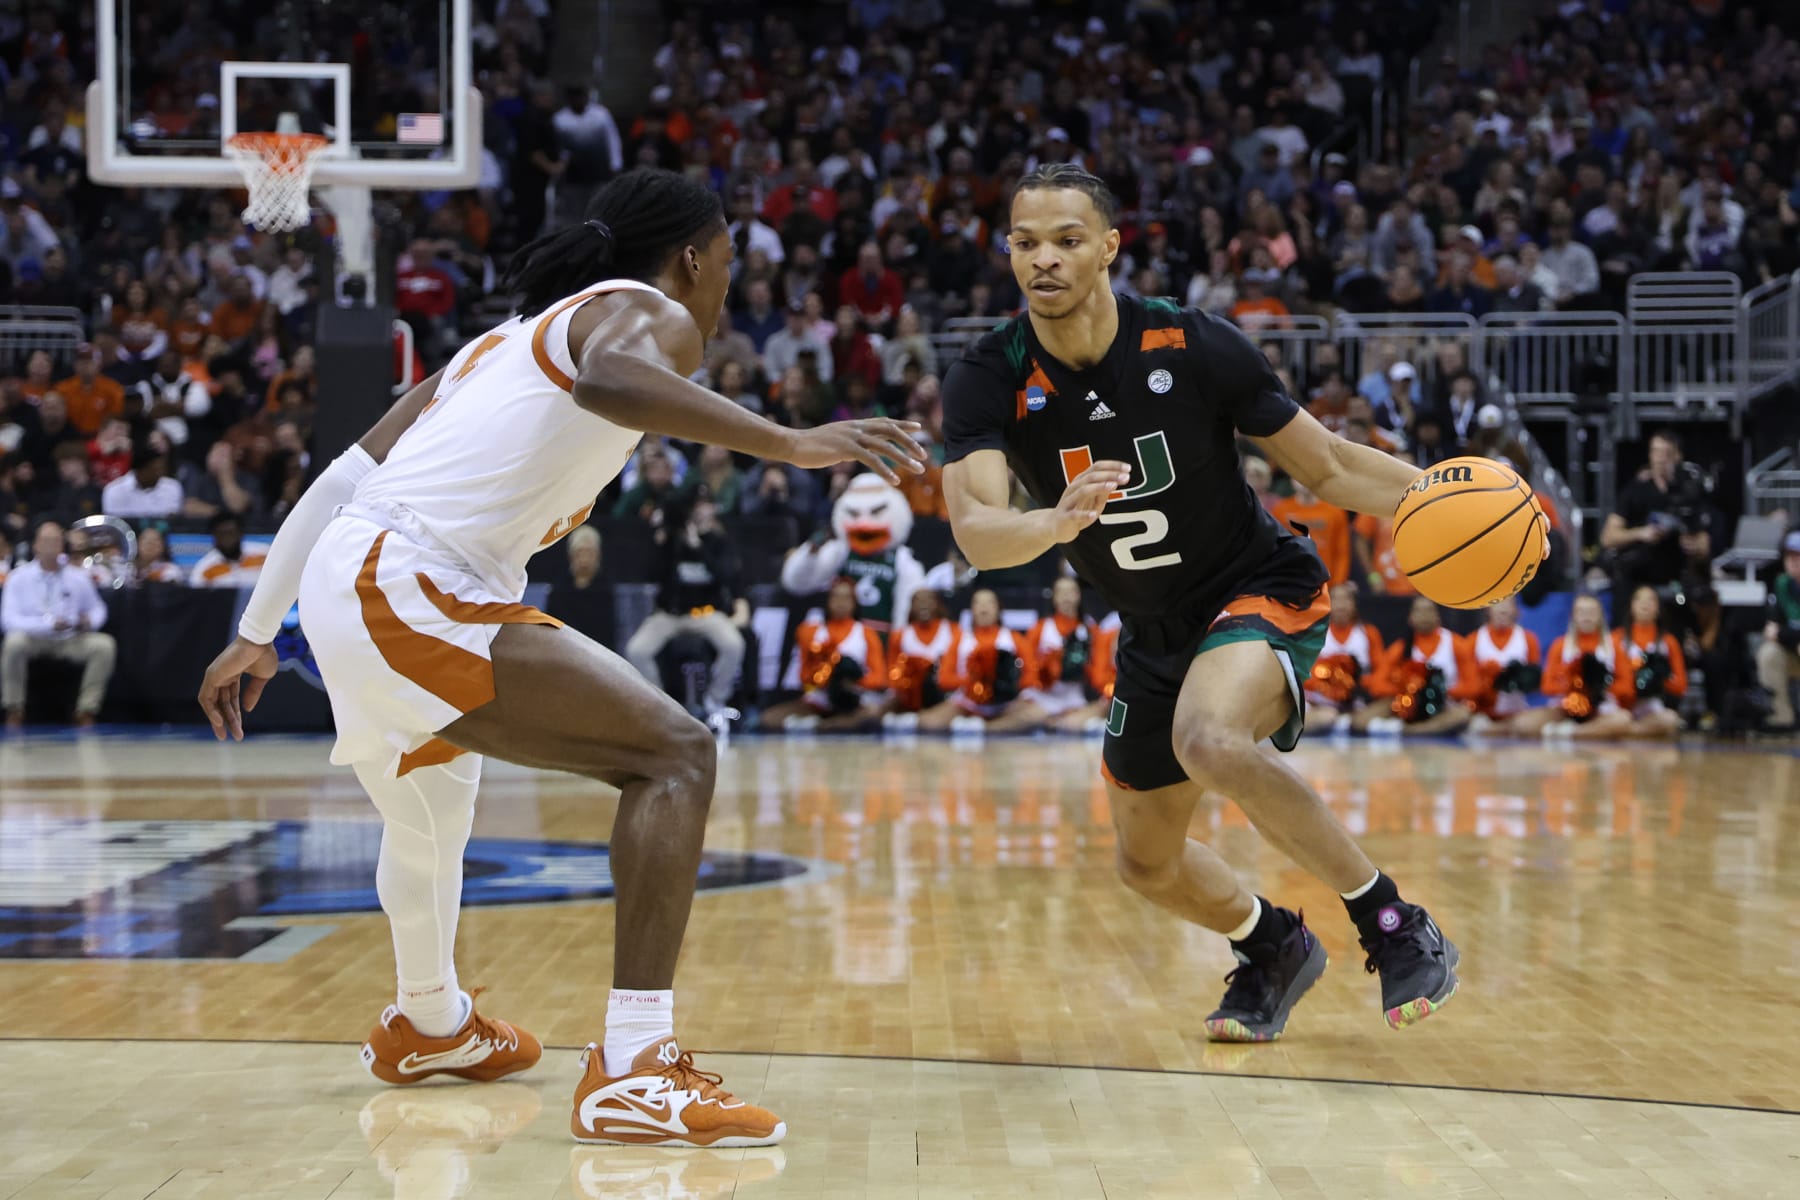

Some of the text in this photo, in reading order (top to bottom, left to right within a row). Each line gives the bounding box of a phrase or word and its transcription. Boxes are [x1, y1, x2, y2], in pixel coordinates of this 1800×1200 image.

[1089, 411, 1117, 421] adidas
[1394, 466, 1474, 516] Wilso
[1099, 509, 1182, 570] 2
[855, 572, 882, 607] 6
